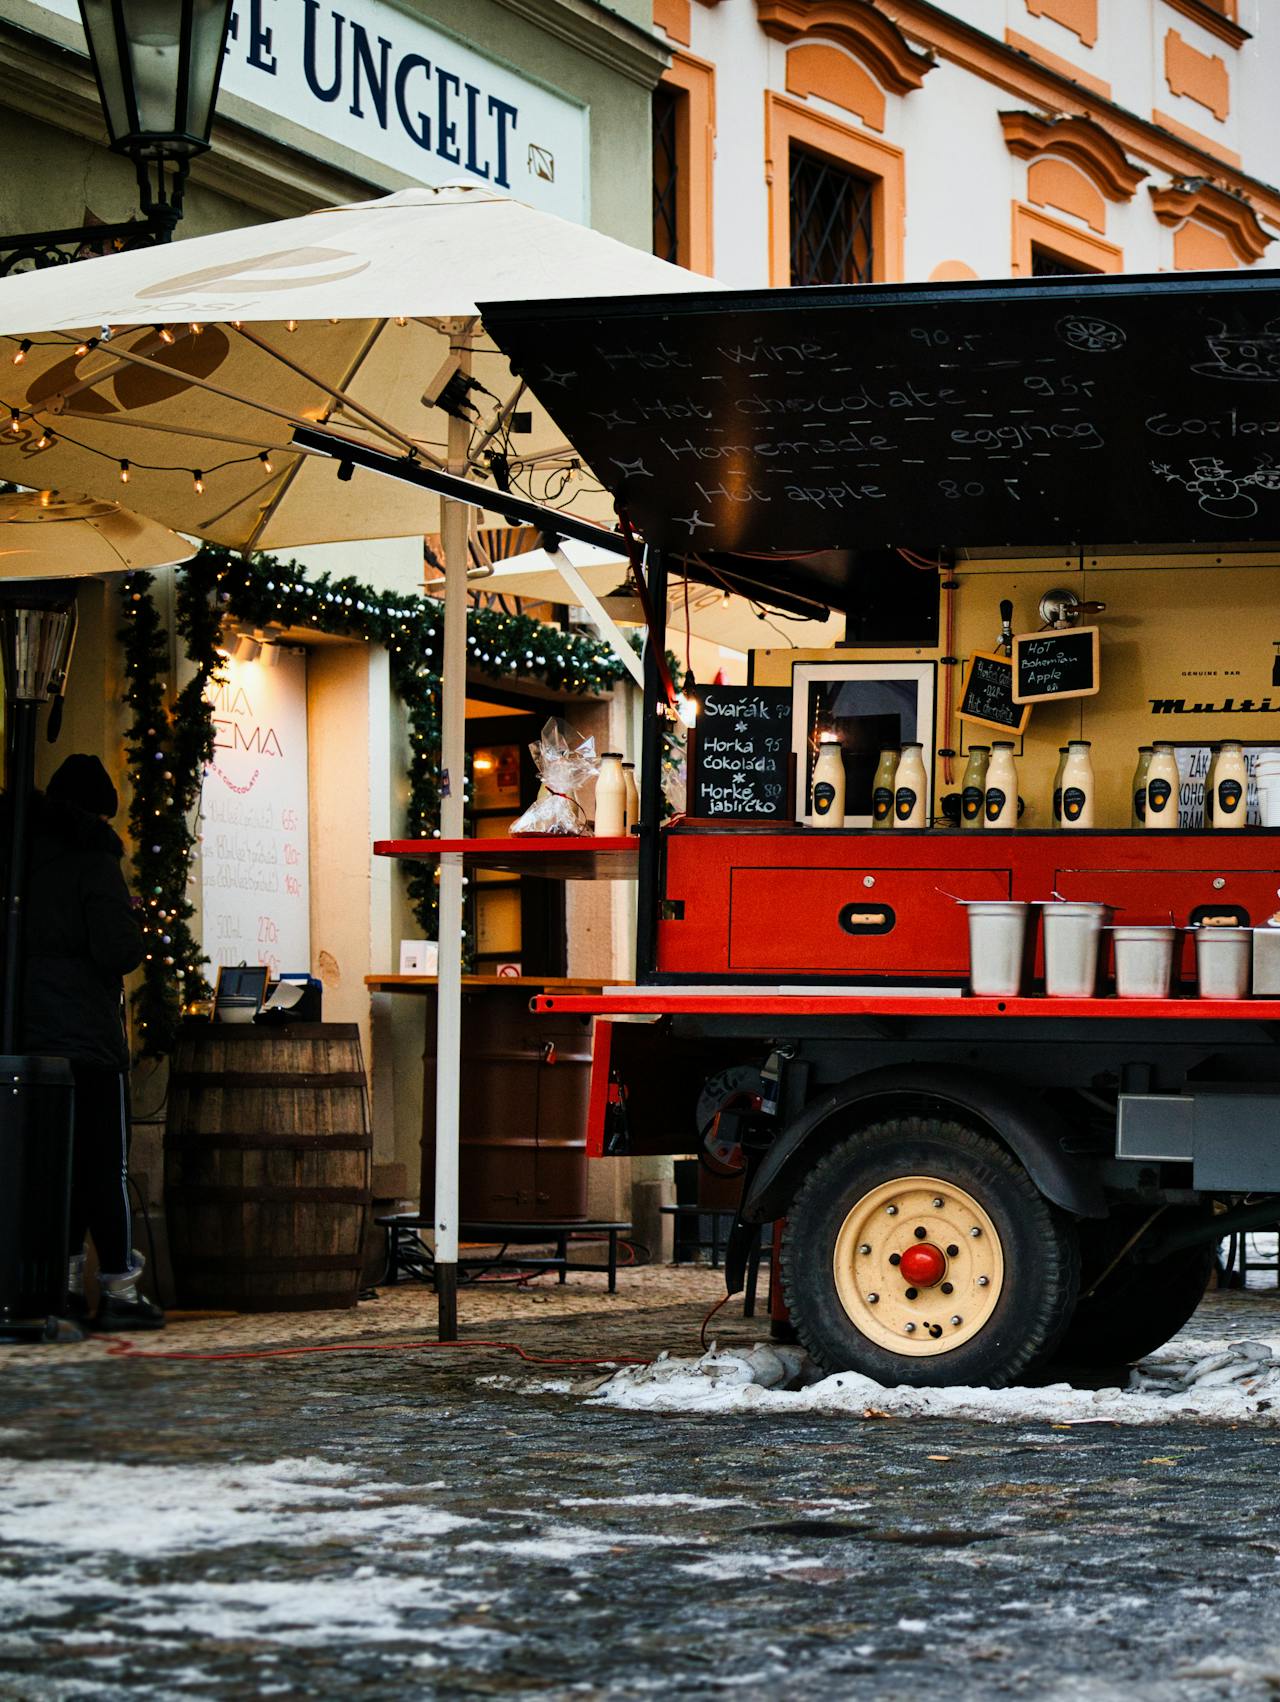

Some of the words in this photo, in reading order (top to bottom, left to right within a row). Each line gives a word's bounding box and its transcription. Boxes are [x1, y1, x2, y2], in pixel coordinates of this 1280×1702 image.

[302, 0, 517, 190] UNGELT
[592, 341, 693, 371] Hot
[716, 337, 838, 363] wine
[632, 397, 712, 420] Hot
[949, 421, 1105, 450] eggnog
[694, 480, 772, 504] Hot
[783, 480, 887, 510] apple
[1027, 668, 1062, 684] Apple
[704, 694, 770, 720] Svařák
[764, 737, 783, 753] 95
[703, 754, 776, 773] čokoláda
[1188, 750, 1208, 777] ZÁK
[701, 781, 755, 800] Horké
